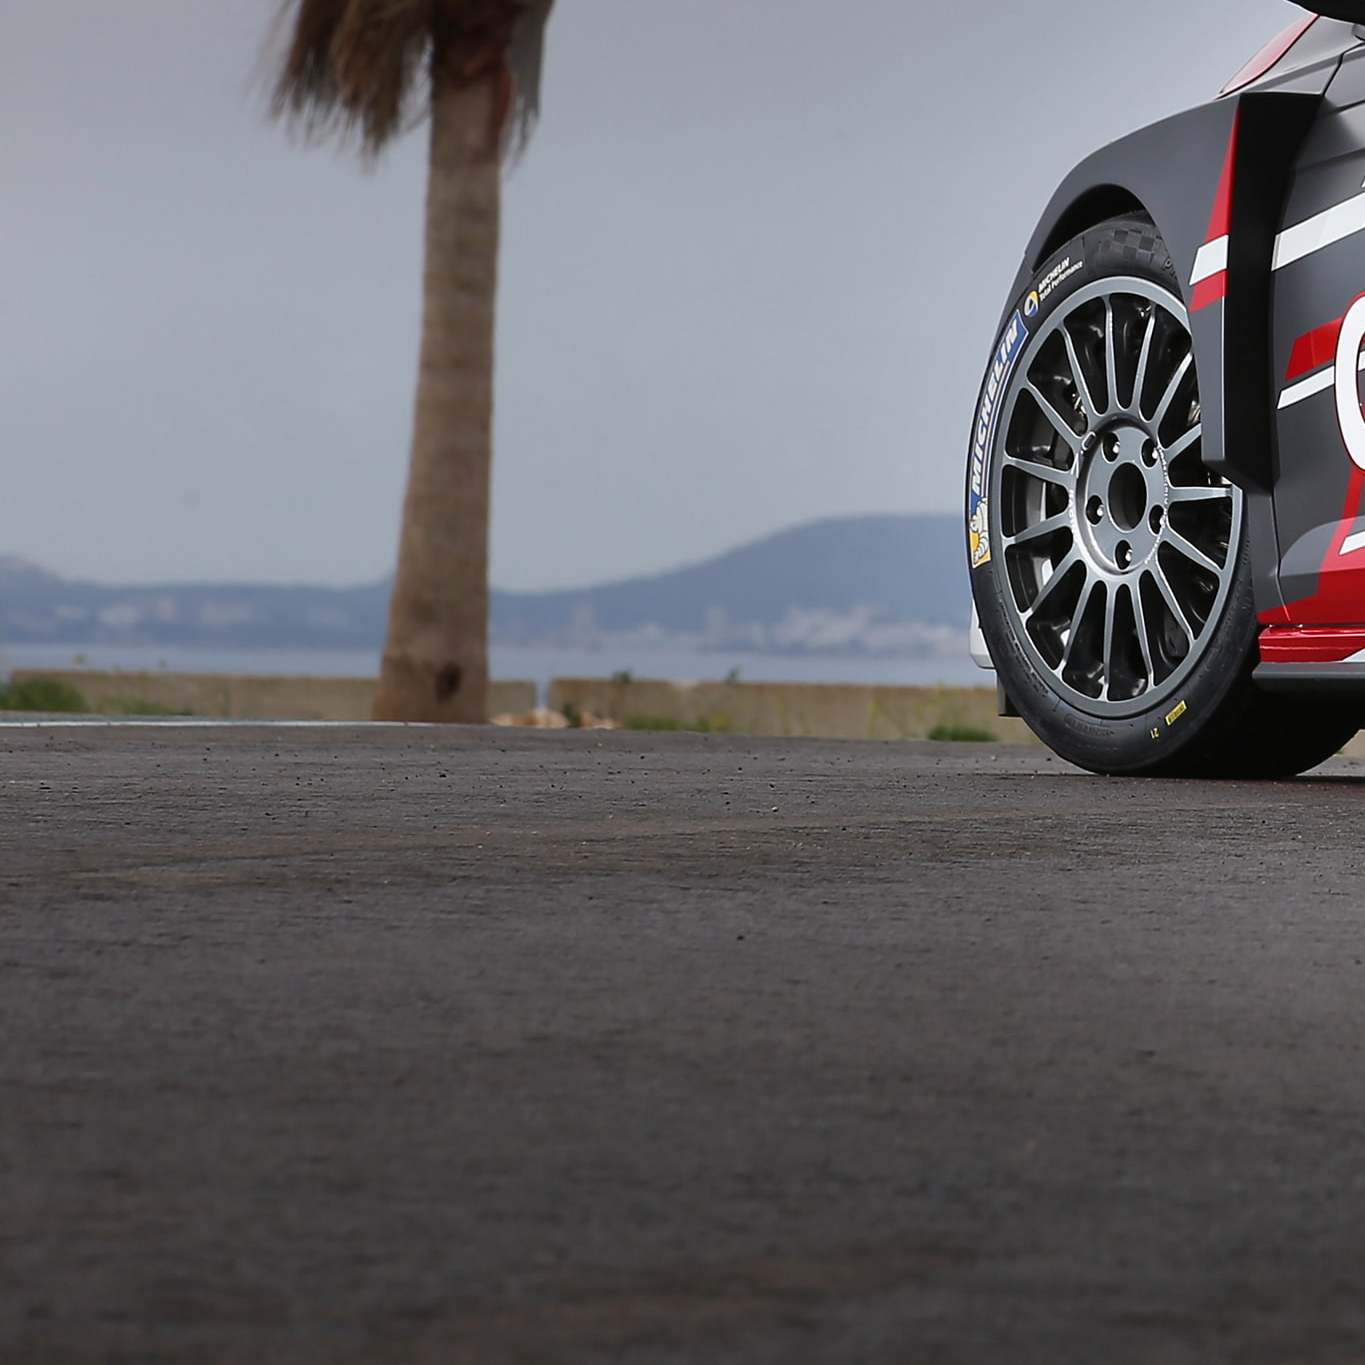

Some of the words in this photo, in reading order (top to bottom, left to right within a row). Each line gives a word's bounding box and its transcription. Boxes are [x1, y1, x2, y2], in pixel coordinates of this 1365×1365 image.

[1038, 257, 1070, 293] MICHELIN
[1039, 286, 1052, 302] Total
[1051, 260, 1083, 290] Performance
[971, 318, 1018, 496] MICHELIN
